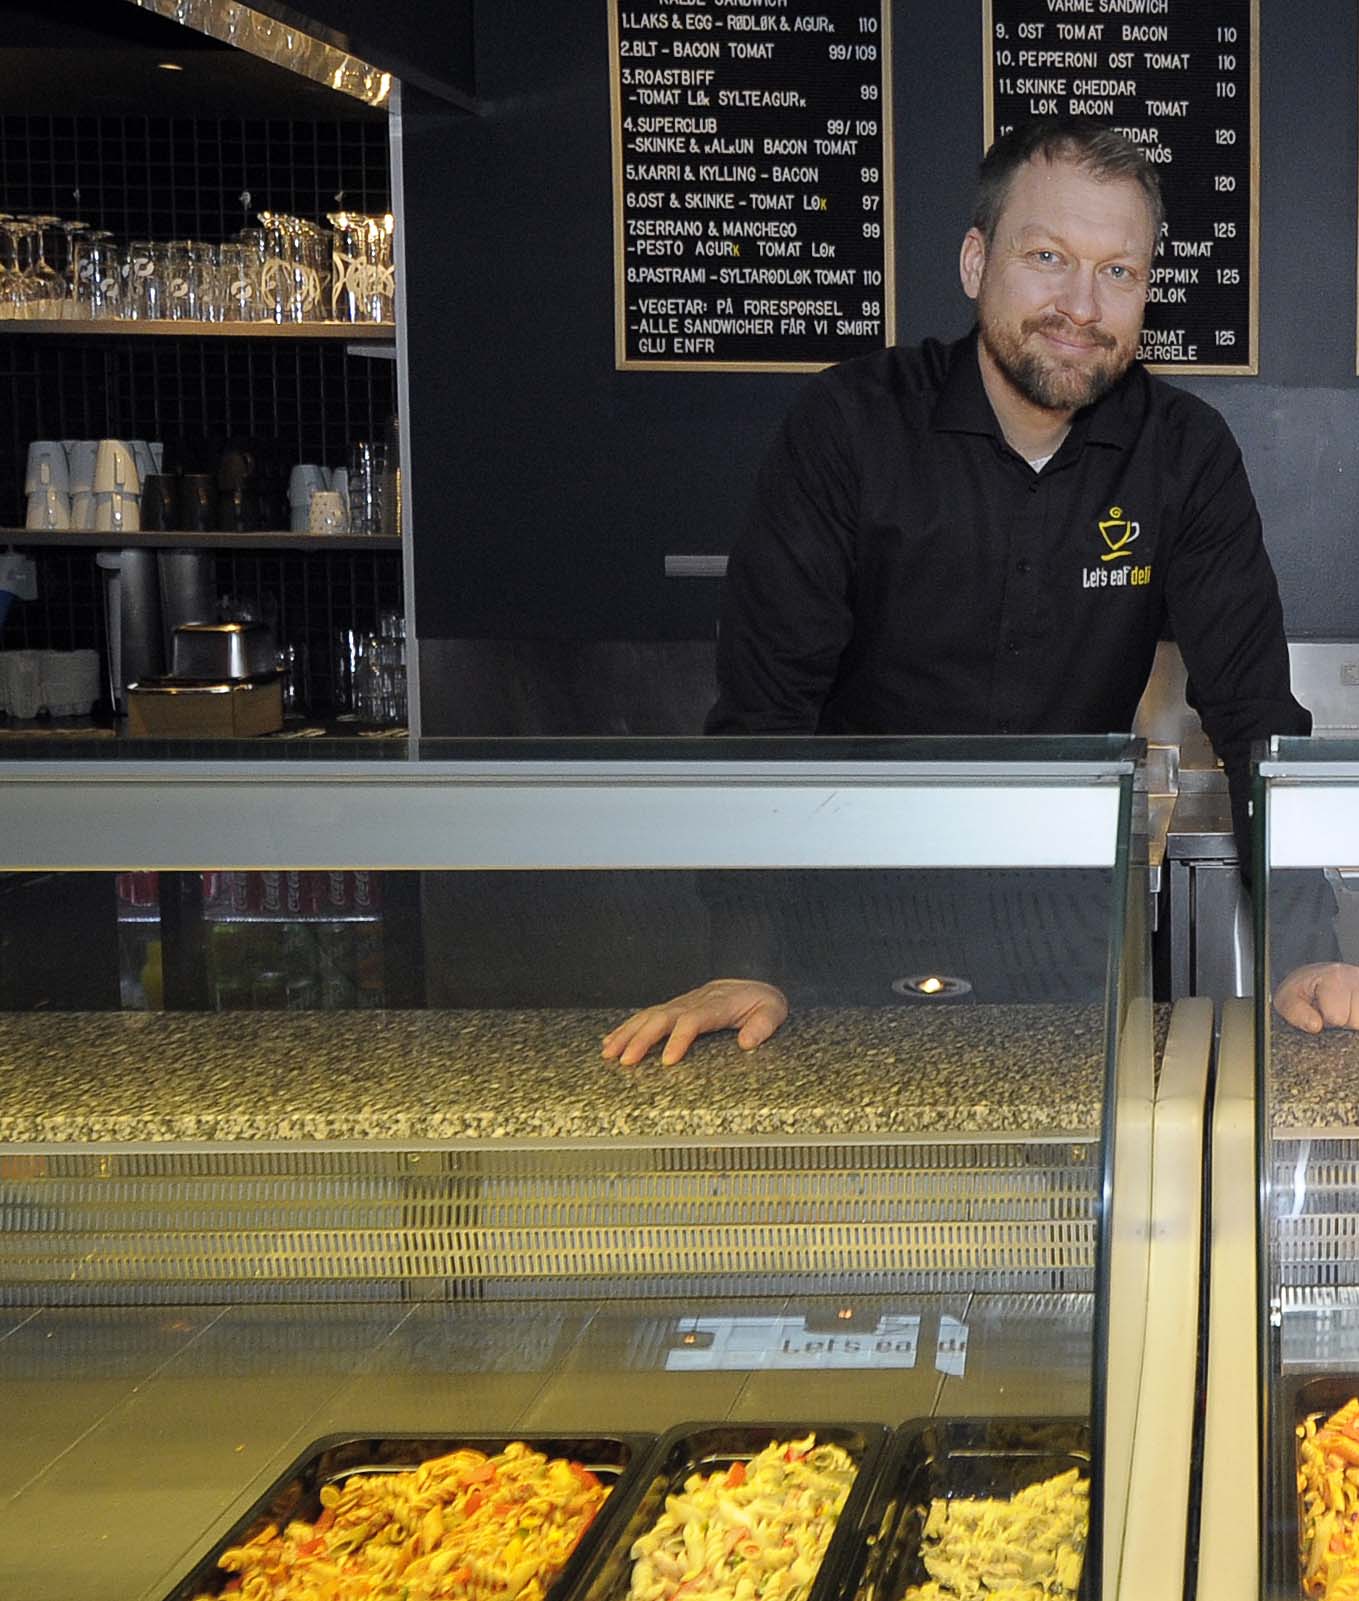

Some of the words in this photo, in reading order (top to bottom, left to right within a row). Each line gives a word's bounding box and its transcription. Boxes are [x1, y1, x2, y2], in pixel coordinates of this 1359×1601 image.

[1046, 0, 1095, 13] VARME
[1098, 0, 1169, 14] SANDWICH
[621, 12, 669, 29] 1.LAKS
[671, 13, 683, 30] &
[685, 13, 713, 31] EGG
[726, 14, 778, 31] RØDLØK
[779, 15, 791, 32] &
[858, 17, 878, 33] 110
[995, 23, 1009, 39] 9.
[1017, 22, 1045, 39] OST
[1056, 23, 1105, 41] TOMAT
[1122, 24, 1168, 42] BACON
[1217, 27, 1237, 43] 110
[620, 40, 659, 57] 2.BLT
[673, 41, 720, 58] BACON
[727, 42, 775, 59] TOMAT
[1018, 50, 1098, 68] PEPPERONI
[1108, 52, 1135, 69] OST
[1143, 52, 1190, 70] TOMAT
[1218, 55, 1236, 71] 110
[621, 68, 715, 86] 3.ROASTBIFF
[628, 88, 682, 105] -TOMAT
[860, 84, 878, 100] 99
[1072, 79, 1137, 96] CHEDDAR
[1216, 81, 1236, 98] 110
[1030, 99, 1059, 115] LØK
[1069, 99, 1114, 116] BACON
[1144, 100, 1190, 117] TOMAT
[623, 116, 718, 134] 4.SUPERCLUB
[627, 136, 686, 153] -SKINKE
[688, 137, 700, 153] &
[763, 138, 808, 155] BACON
[813, 139, 858, 156] TOMAT
[1215, 129, 1237, 145] 120
[626, 164, 681, 181] 5.KARRI
[683, 165, 696, 181] &
[699, 165, 757, 182] KYLLING
[772, 166, 819, 183] BACON
[860, 167, 879, 183] 99
[1214, 175, 1236, 192] 120
[626, 192, 665, 208] 6.OST
[669, 192, 681, 209] &
[684, 193, 735, 209] SKINKE
[749, 193, 795, 210] TOMAT
[862, 195, 880, 211] 97
[707, 220, 720, 237] &
[722, 221, 798, 238] MANCHEGO
[862, 222, 881, 239] 99
[1213, 222, 1237, 238] 125
[627, 239, 684, 256] -PESTO
[756, 241, 803, 257] TOMAT
[1170, 241, 1214, 257] TOMAT
[627, 267, 706, 283] 8.PASTRAMI
[813, 269, 857, 285] TOMAT
[863, 270, 882, 286] 110
[1216, 268, 1240, 285] 125
[716, 297, 734, 315] PÅ
[743, 299, 843, 316] FORESPØRSEL
[861, 301, 881, 317] 98
[630, 318, 679, 334] -ALLE
[683, 318, 774, 335] SANDWICHER
[780, 317, 806, 335] FÅR
[813, 319, 828, 335] VI
[836, 320, 881, 336] SMØRT
[638, 338, 666, 353] GLU
[673, 337, 715, 354] ENFR
[1141, 329, 1186, 345] TOMAT
[1215, 330, 1236, 346] 125
